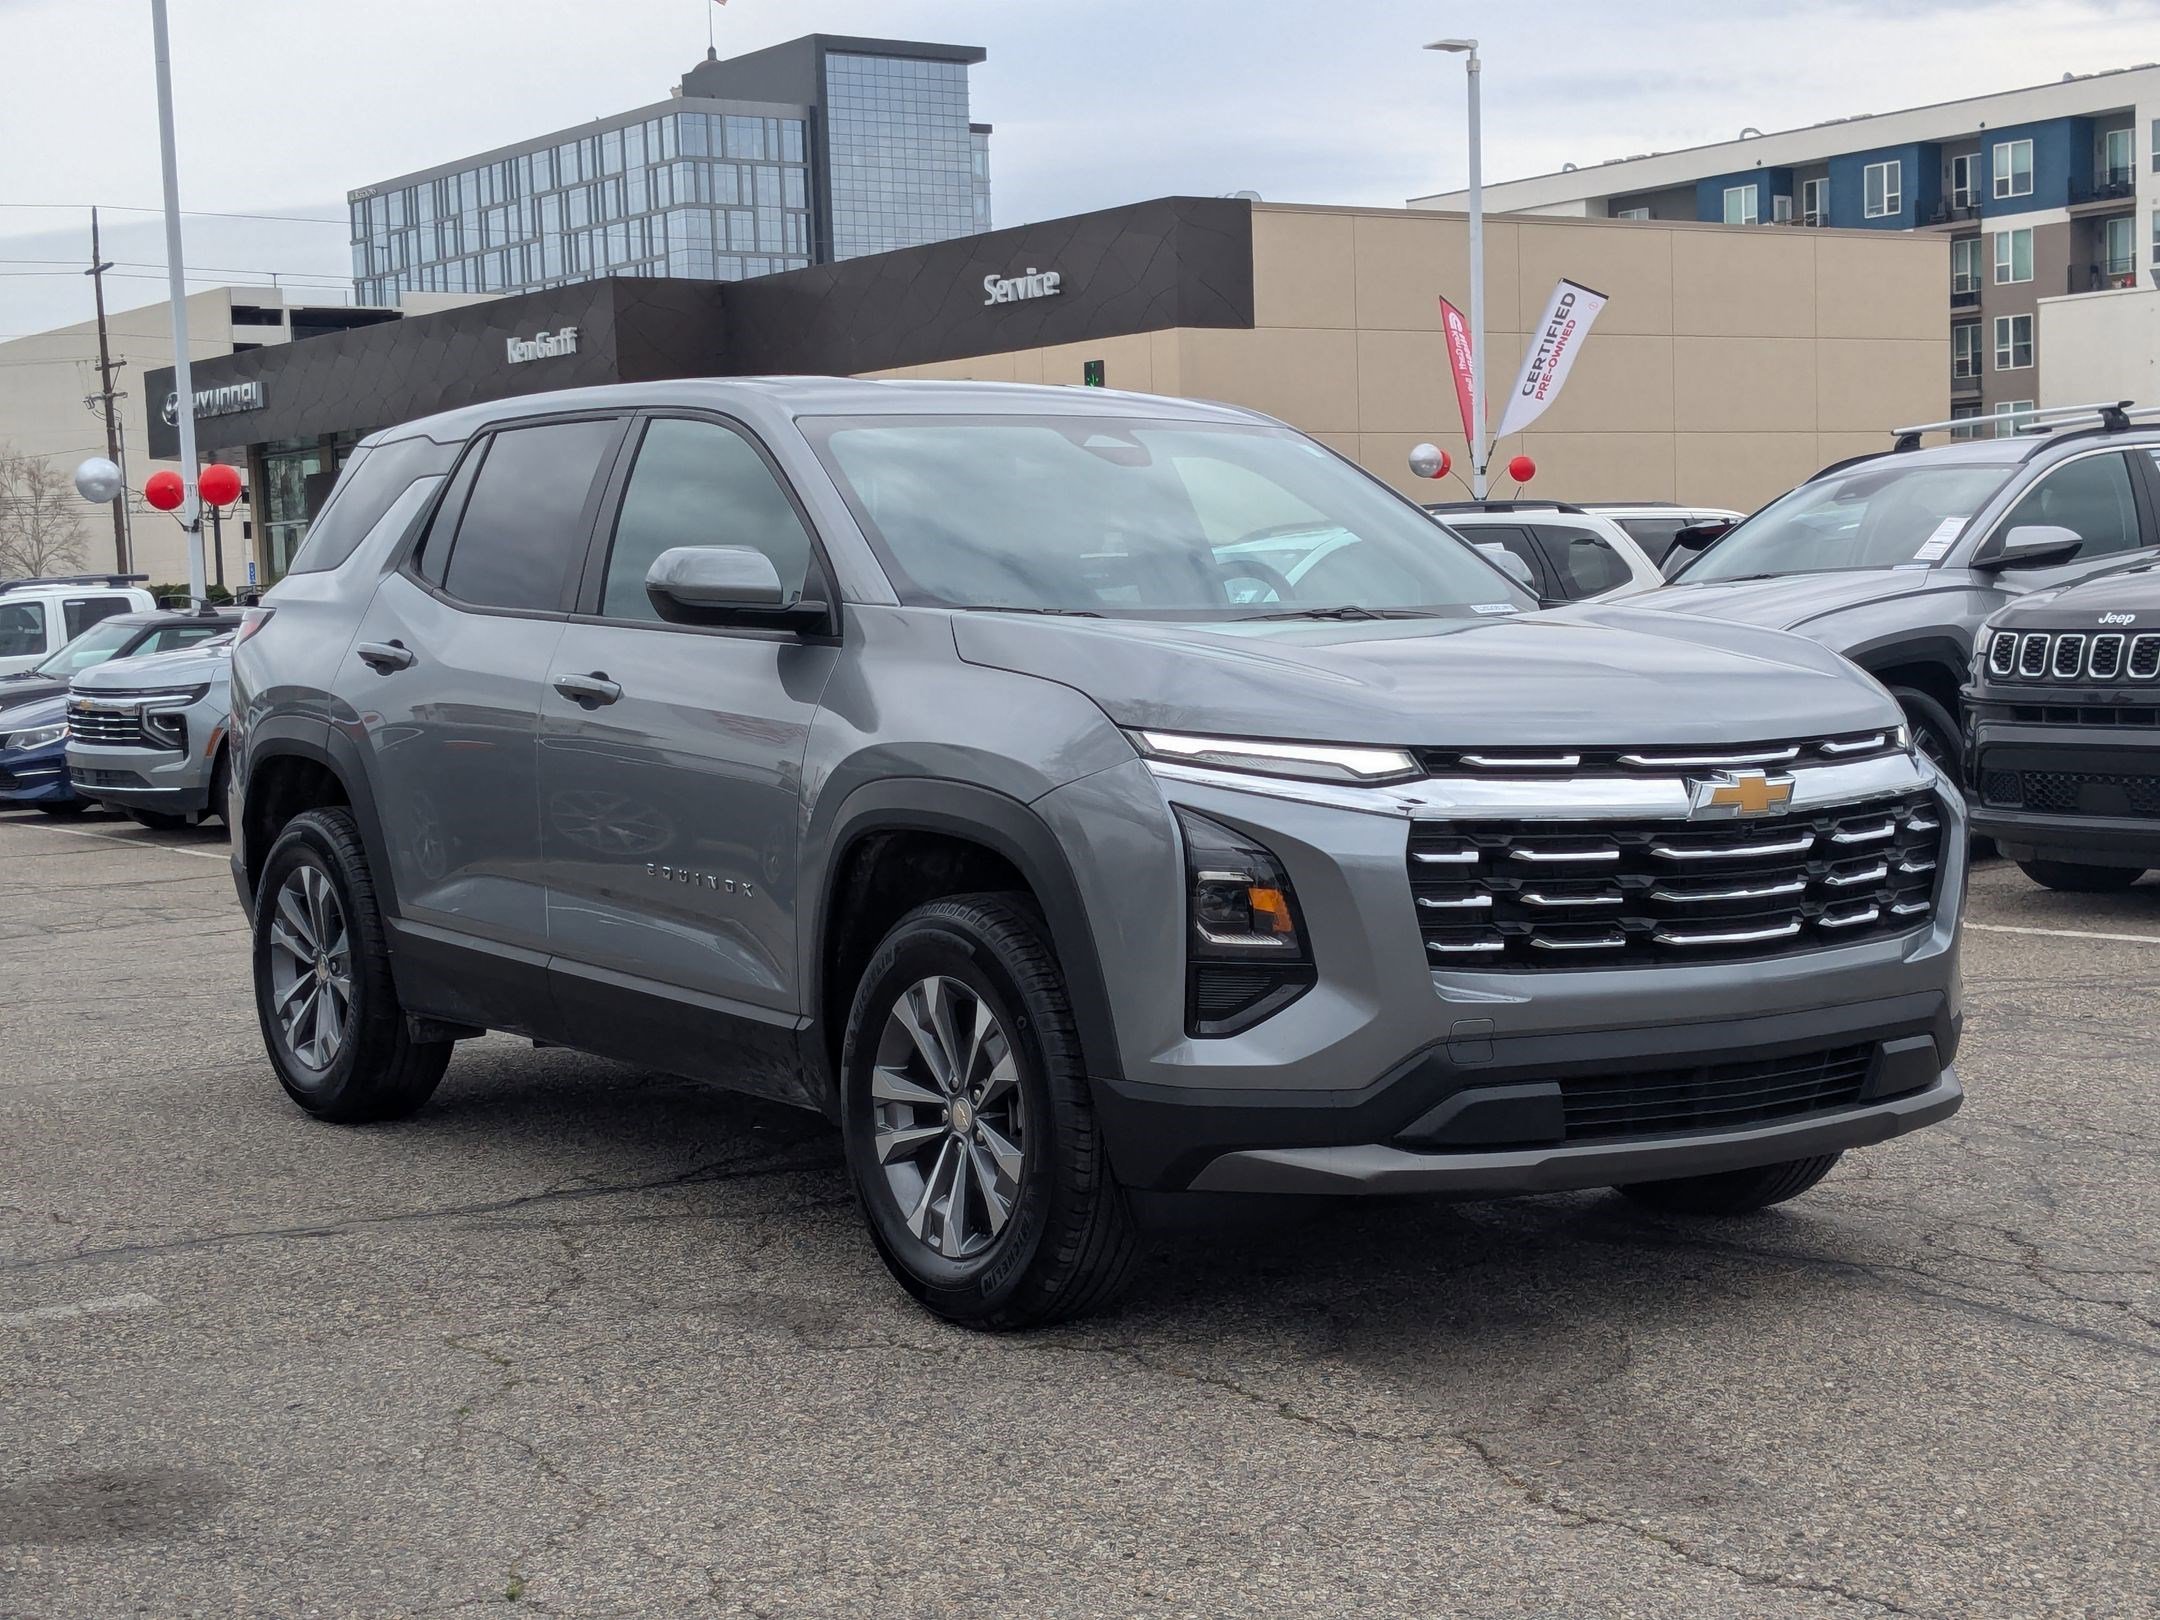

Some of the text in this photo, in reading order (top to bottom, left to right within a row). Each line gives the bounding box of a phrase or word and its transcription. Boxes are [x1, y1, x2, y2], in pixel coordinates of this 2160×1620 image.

[984, 267, 1060, 306] Service
[507, 327, 577, 364] Ken Garff
[1521, 292, 1576, 396] CERTIFIED
[1535, 319, 1576, 401] PRE-OWNED
[2098, 612, 2136, 626] Jeep
[646, 863, 754, 898] EQUINOX
